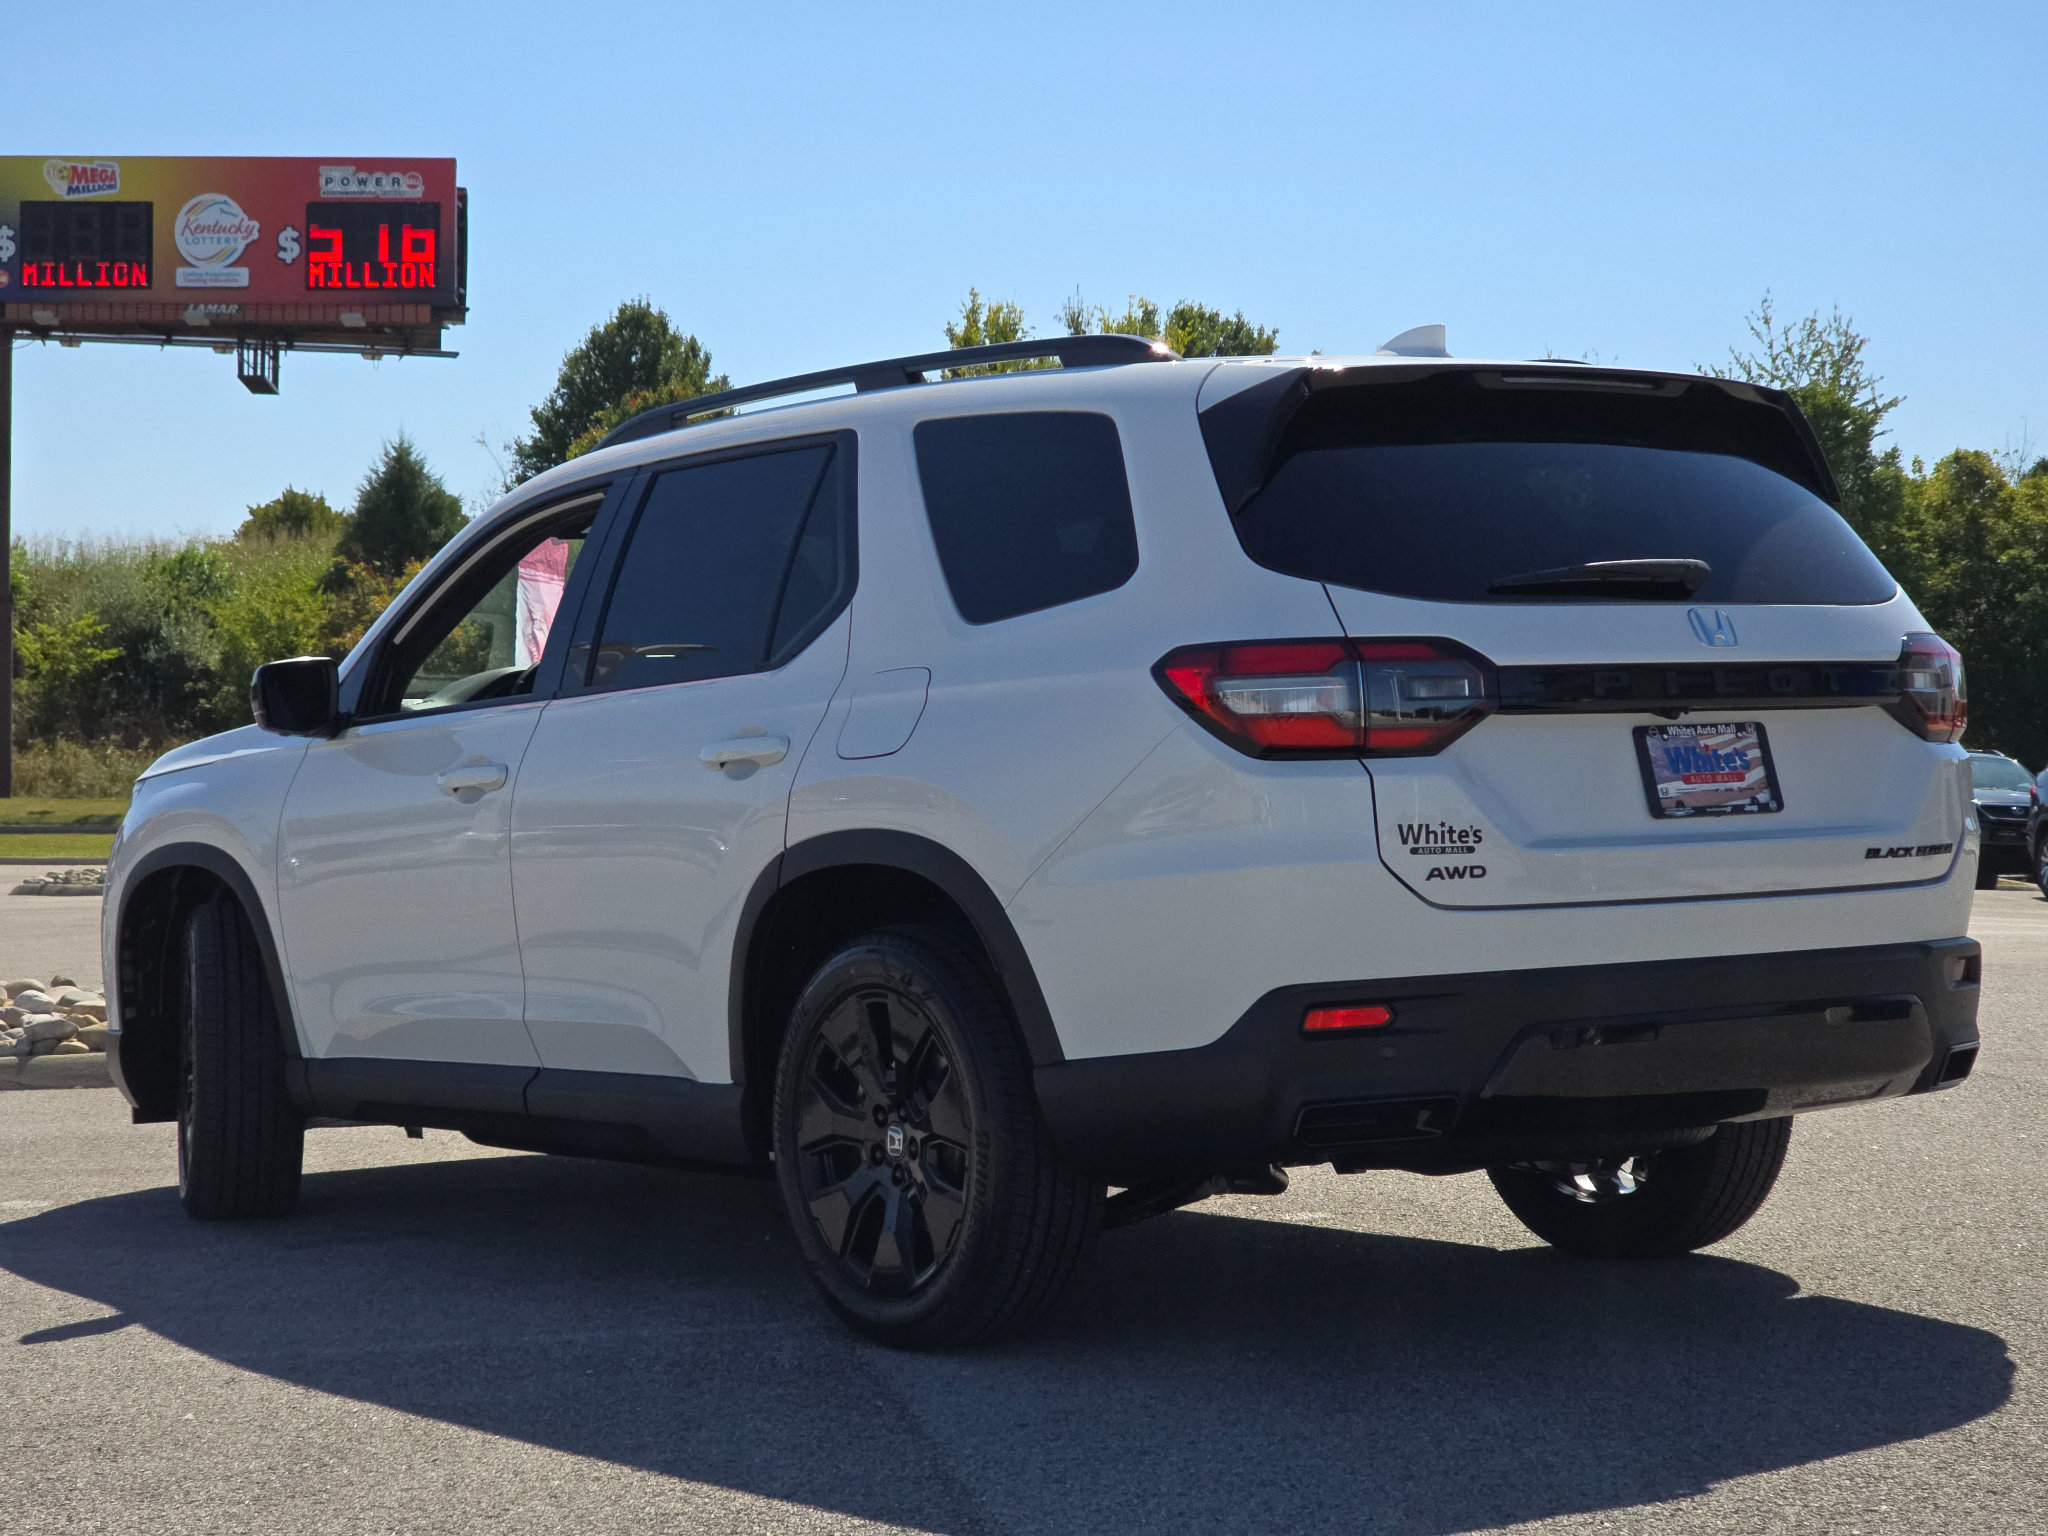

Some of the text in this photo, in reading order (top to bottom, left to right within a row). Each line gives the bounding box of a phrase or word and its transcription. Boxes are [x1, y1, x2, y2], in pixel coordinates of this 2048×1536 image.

[69, 164, 117, 185] MEGA
[181, 217, 256, 240] Kentucky
[184, 236, 239, 246] LOTTERY
[276, 226, 301, 264] $
[22, 262, 148, 287] MILLION
[309, 262, 436, 288] MILLION
[187, 303, 239, 314] LAMAR
[1667, 723, 1738, 737] White's Auto Mall
[1664, 744, 1751, 774] White's
[1690, 774, 1739, 784] AUTO MALL
[1397, 820, 1483, 846] White's
[1417, 846, 1469, 855] AUTO MALL
[1864, 845, 1916, 860] BLACK
[1425, 865, 1488, 882] AWD
